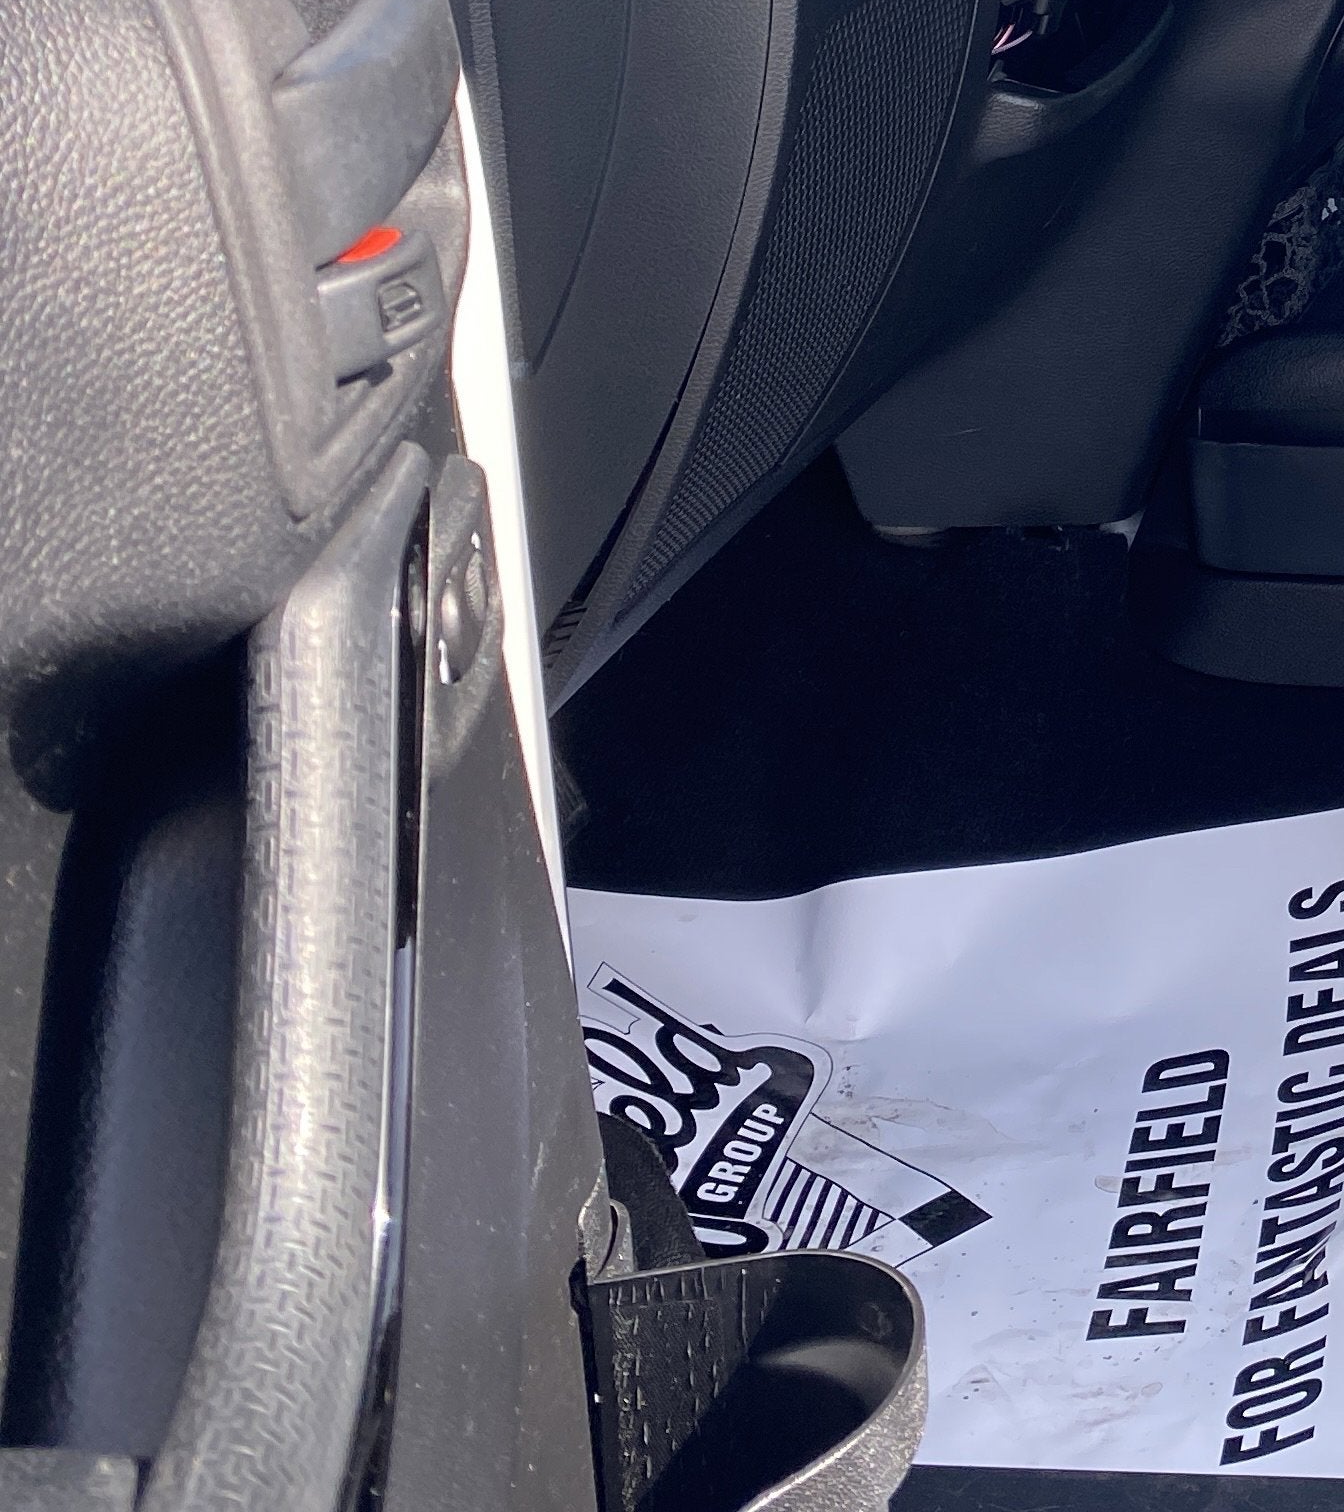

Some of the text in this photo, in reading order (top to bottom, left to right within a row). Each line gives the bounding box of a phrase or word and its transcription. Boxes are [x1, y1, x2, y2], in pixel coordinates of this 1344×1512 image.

[696, 1104, 785, 1204] GROUP
[1086, 1048, 1230, 1340] FAIRFIELD
[1219, 1335, 1327, 1466] FOR
